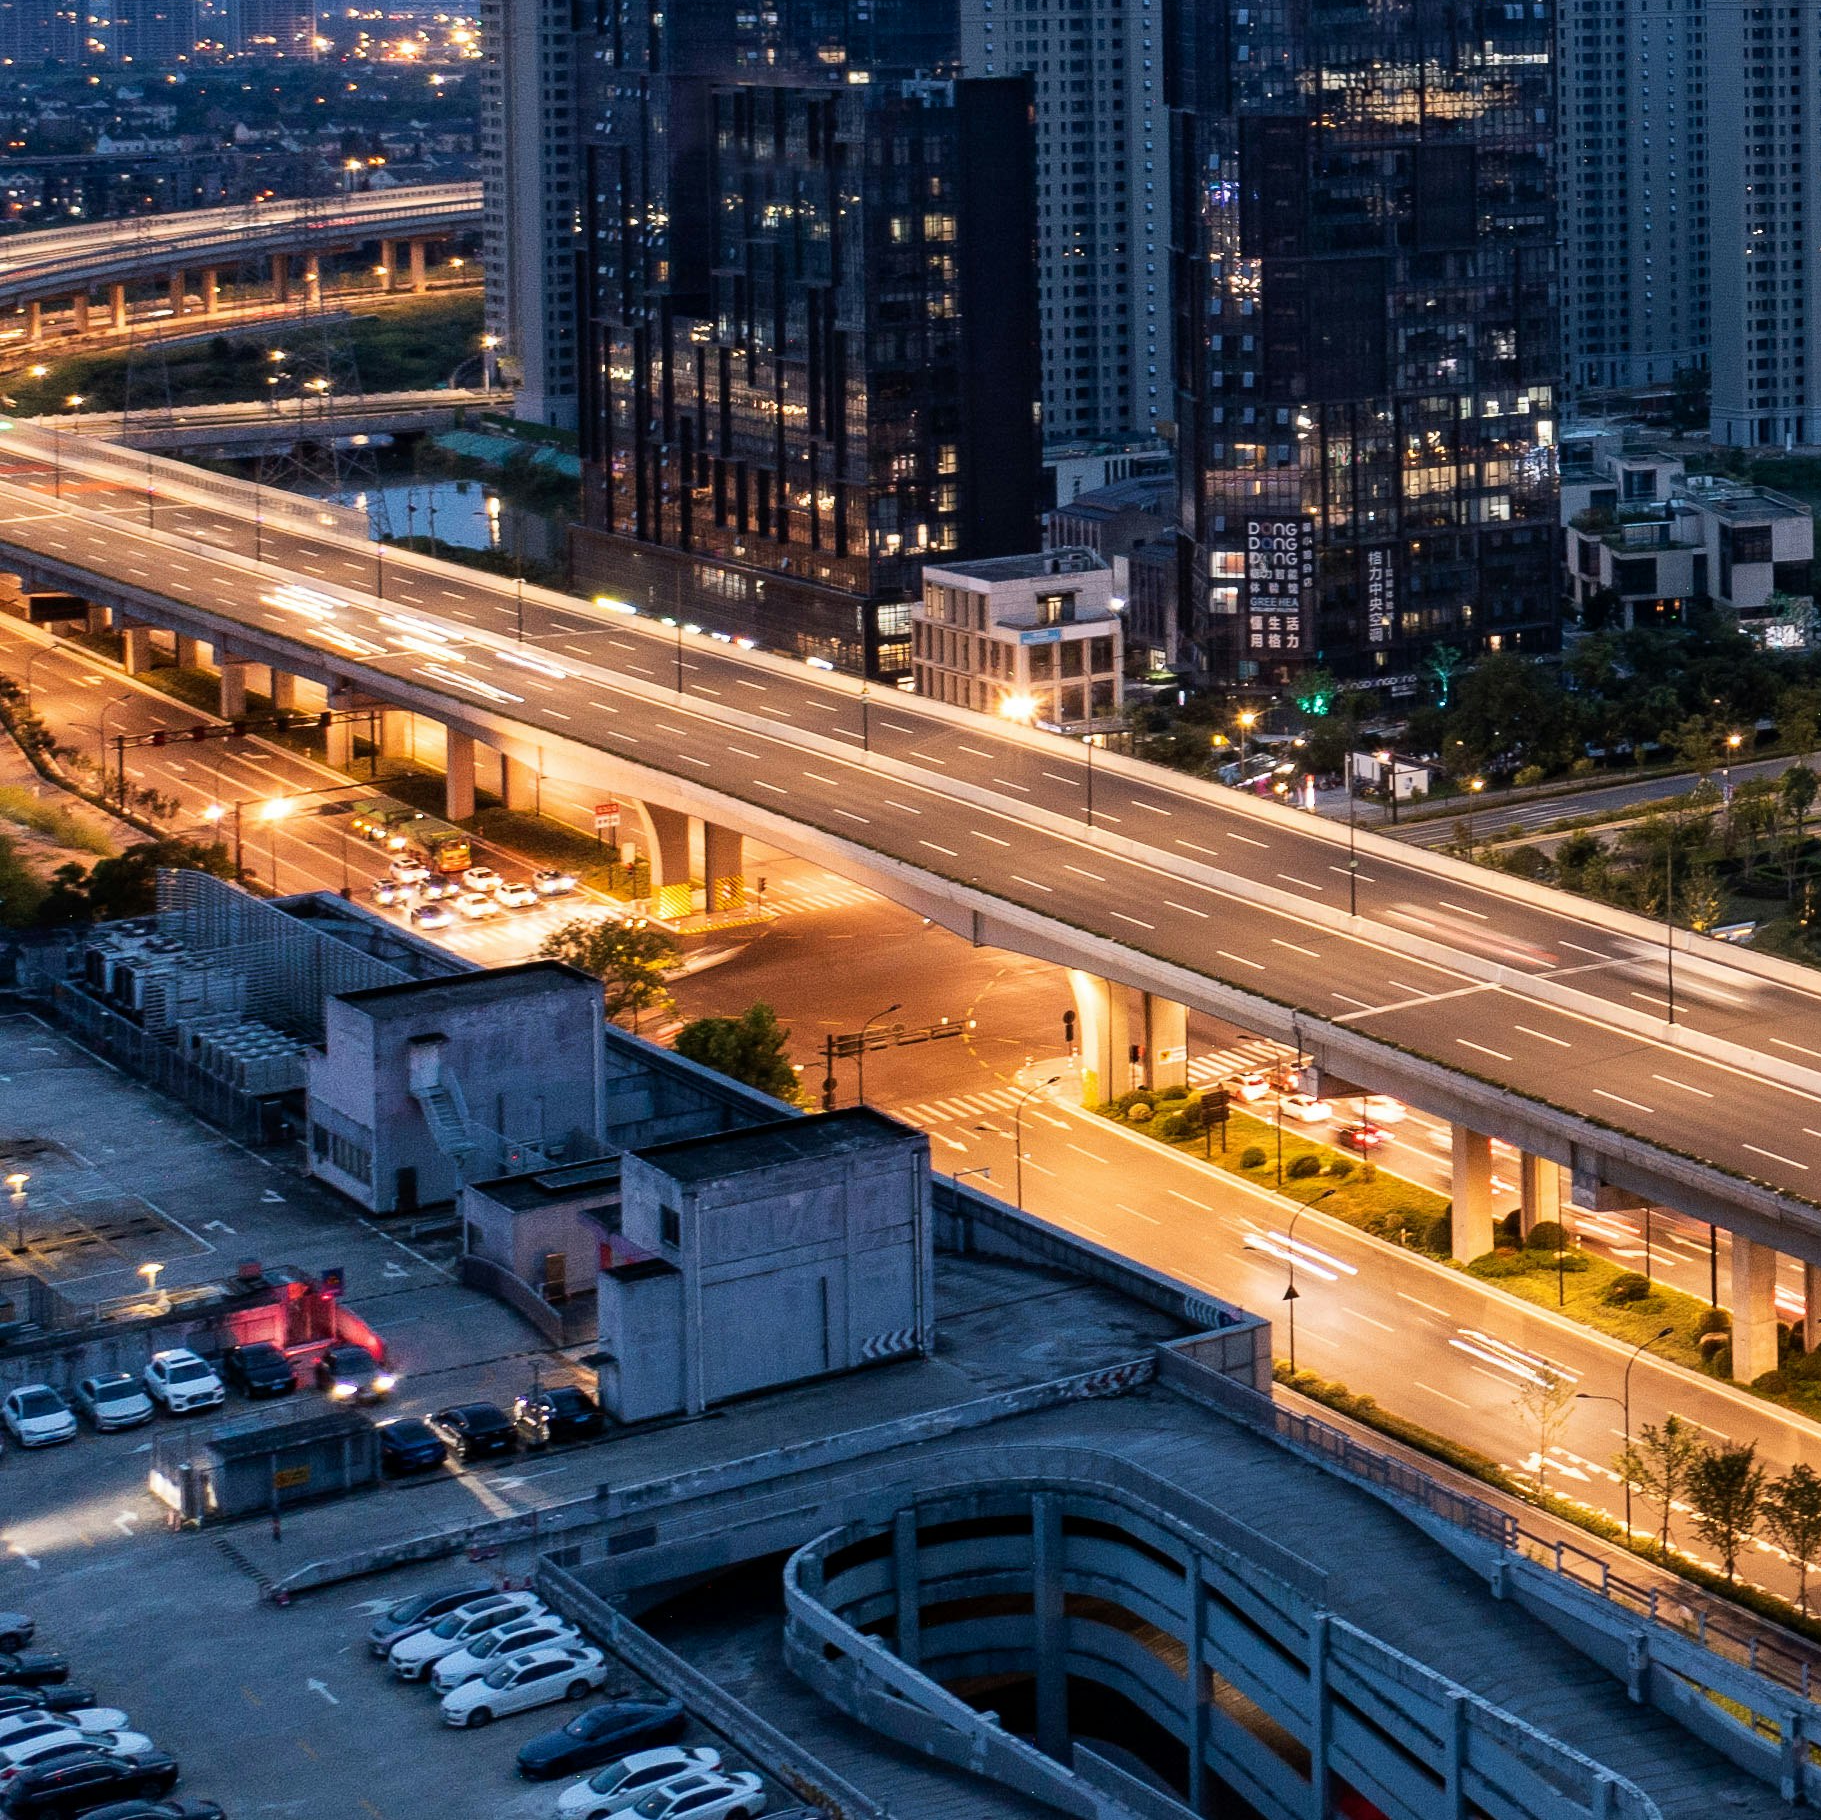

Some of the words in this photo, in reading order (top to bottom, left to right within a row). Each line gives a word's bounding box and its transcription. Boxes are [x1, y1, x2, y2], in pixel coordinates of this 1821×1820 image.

[1250, 597, 1277, 607] GREE
[1368, 551, 1383, 642] 格力中央空调
